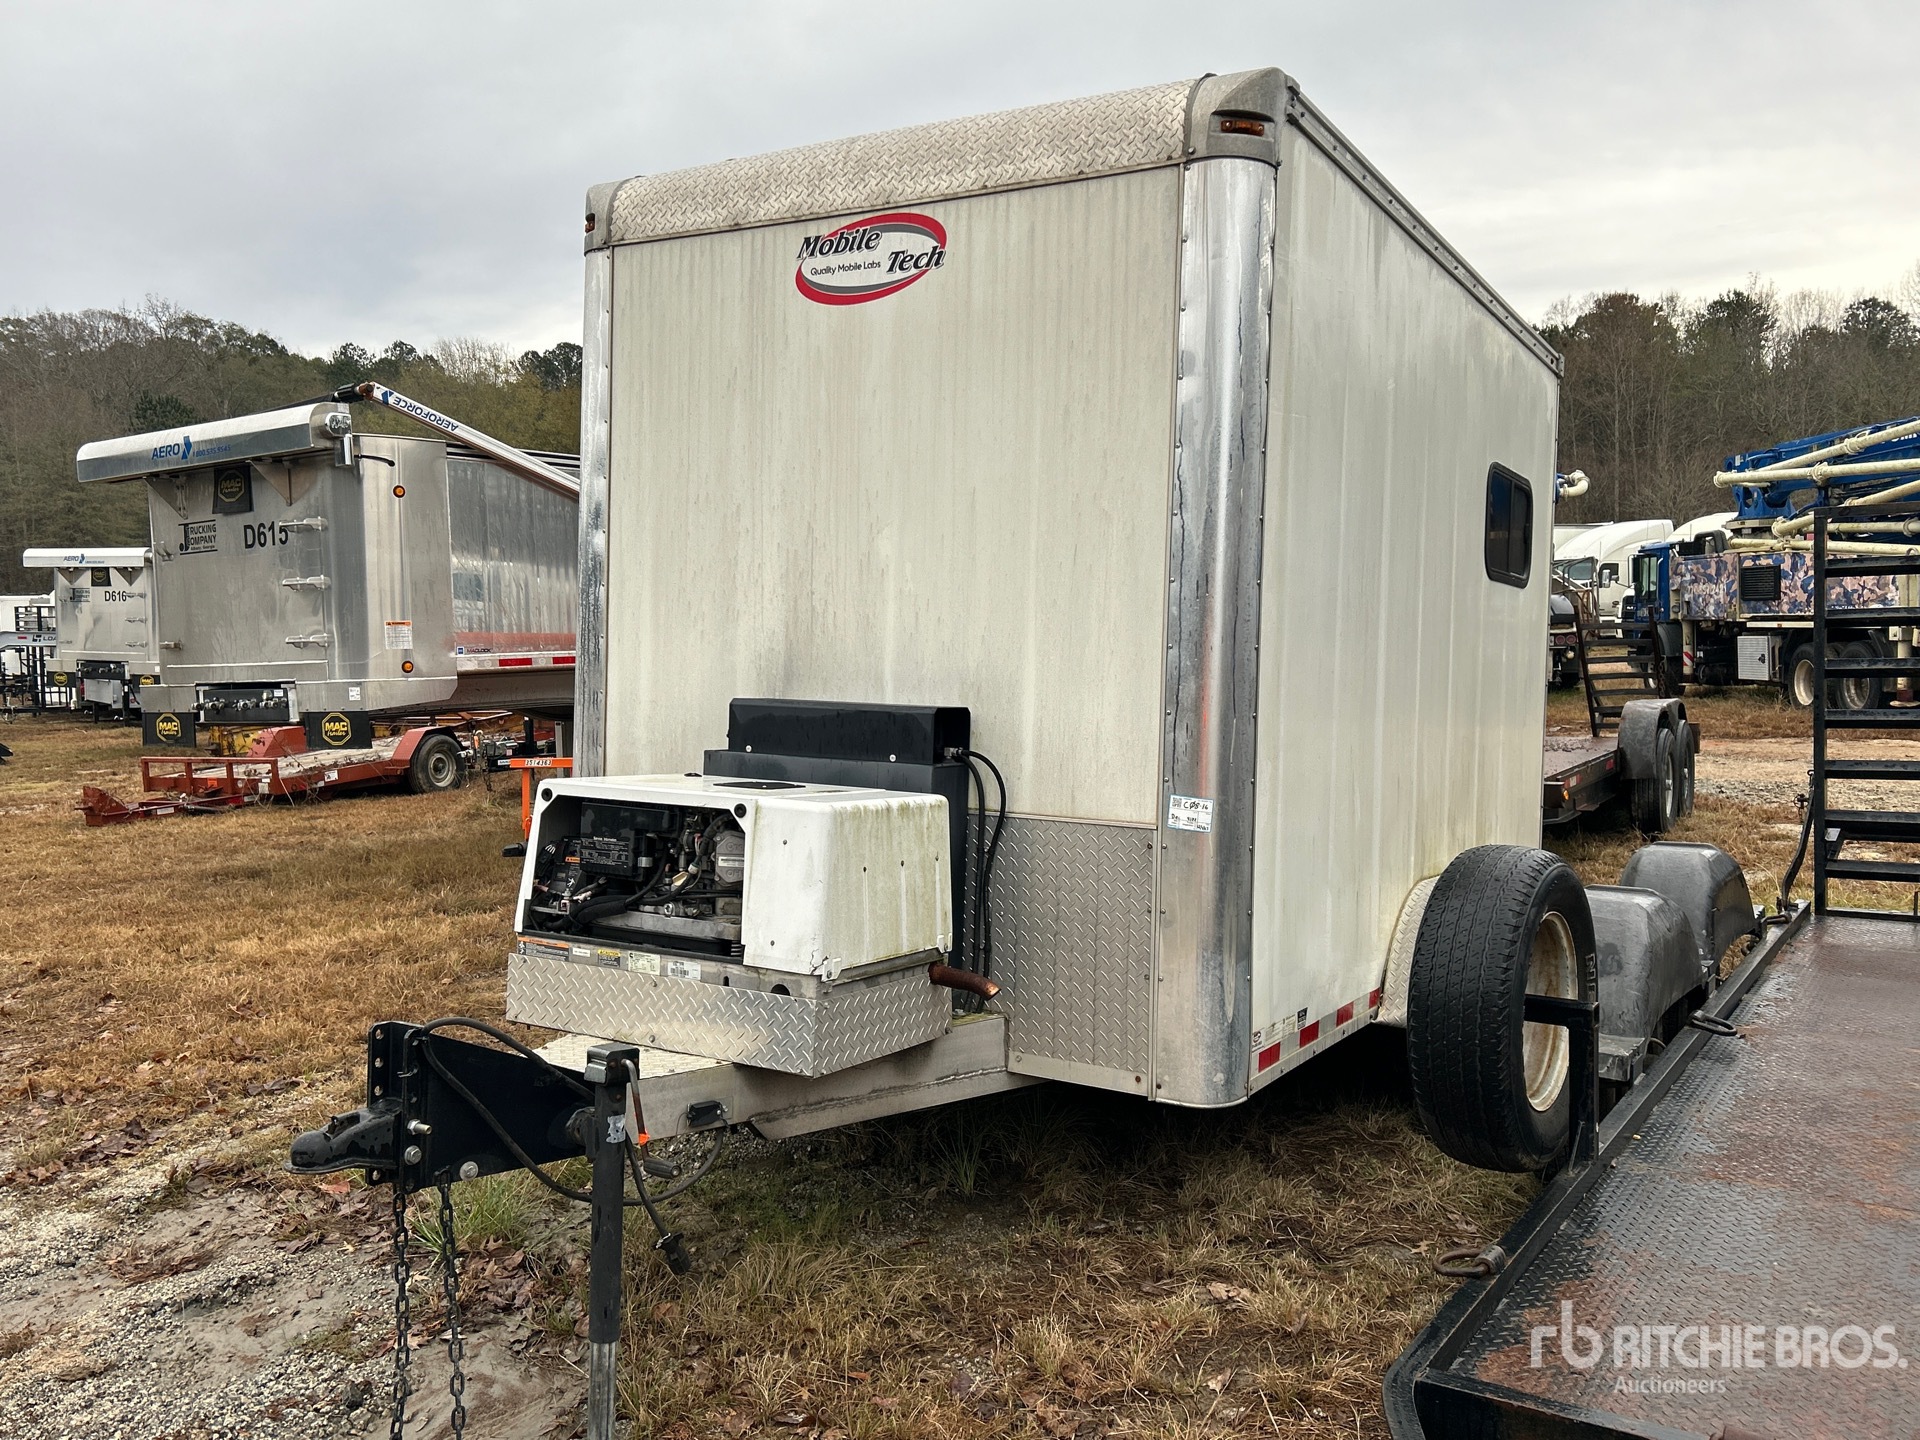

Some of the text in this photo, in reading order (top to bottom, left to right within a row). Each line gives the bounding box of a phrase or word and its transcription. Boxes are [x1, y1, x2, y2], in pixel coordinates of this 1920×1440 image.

[797, 227, 882, 259] Mobile
[886, 245, 945, 273] Tech
[810, 260, 881, 276] Quality Mobile Labs
[393, 396, 459, 431] AEROFORCE
[152, 443, 180, 460] AERO
[221, 479, 242, 488] MAC
[244, 521, 288, 549] D615
[104, 591, 127, 602] D616
[159, 721, 178, 731] MAC
[325, 721, 348, 731] MAC
